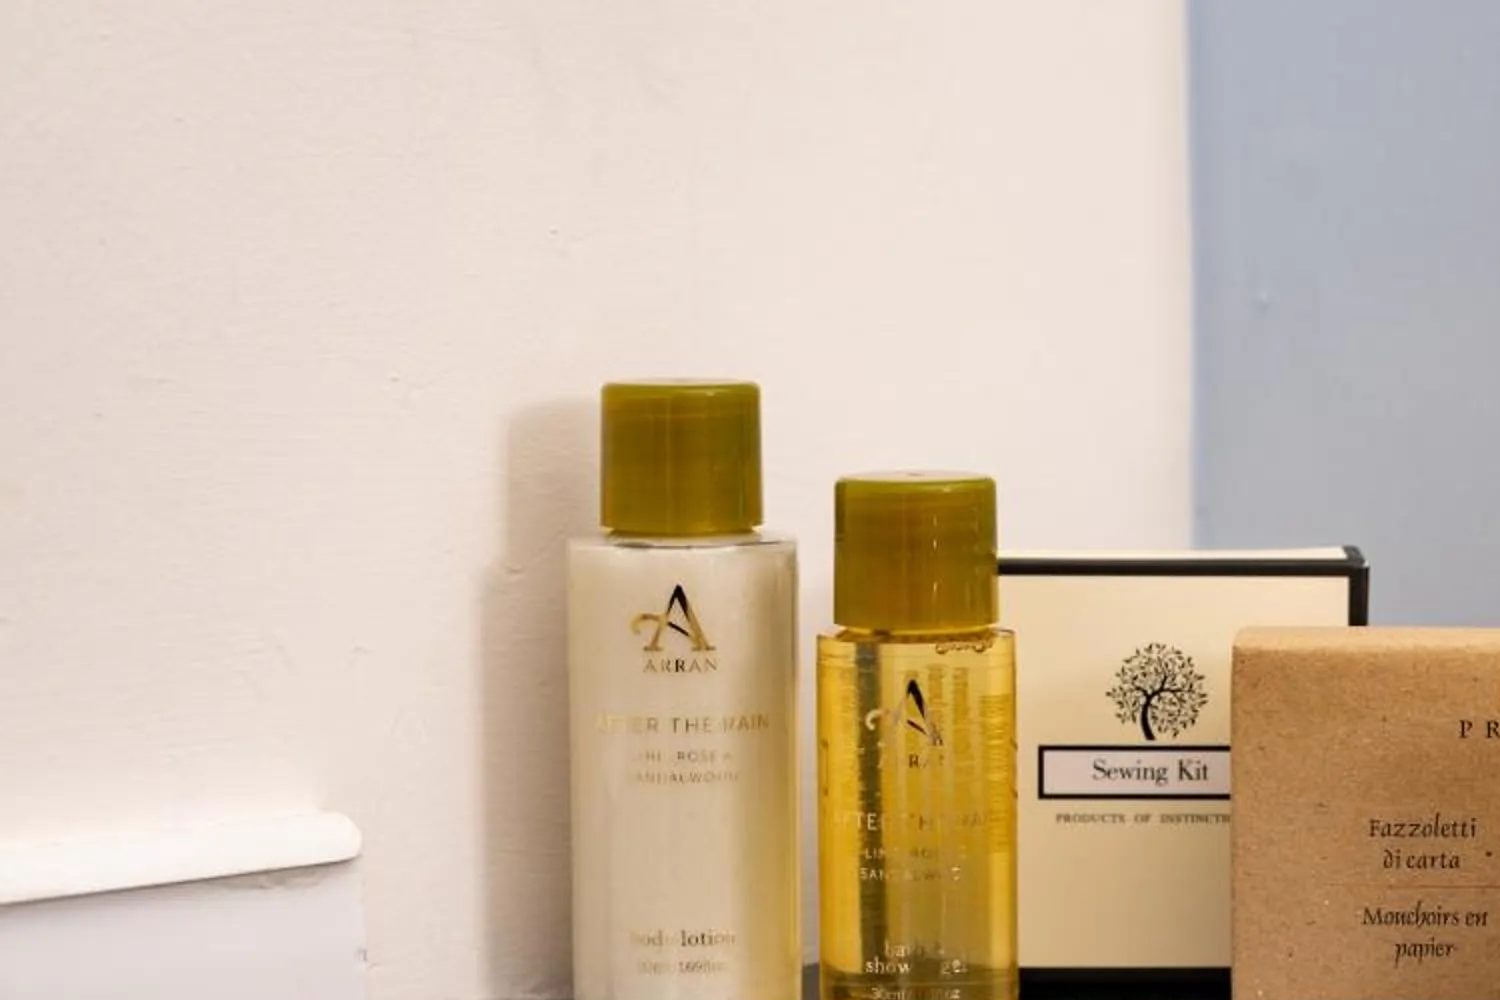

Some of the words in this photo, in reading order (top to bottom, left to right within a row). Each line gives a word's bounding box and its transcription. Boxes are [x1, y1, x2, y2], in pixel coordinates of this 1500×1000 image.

[643, 658, 718, 673] ARRAN
[672, 716, 713, 734] THE
[1092, 758, 1168, 786] Sewing
[1178, 758, 1209, 781] Kit
[1056, 813, 1125, 824] PRODUCTS
[1134, 813, 1151, 824] OF
[1368, 812, 1478, 838] Fazzoletti
[1383, 849, 1400, 869] di
[1406, 850, 1460, 869] carta
[1362, 900, 1459, 928] Mouchoirs
[1465, 911, 1488, 927] en
[681, 928, 736, 947] lotion
[1395, 936, 1454, 968] papier
